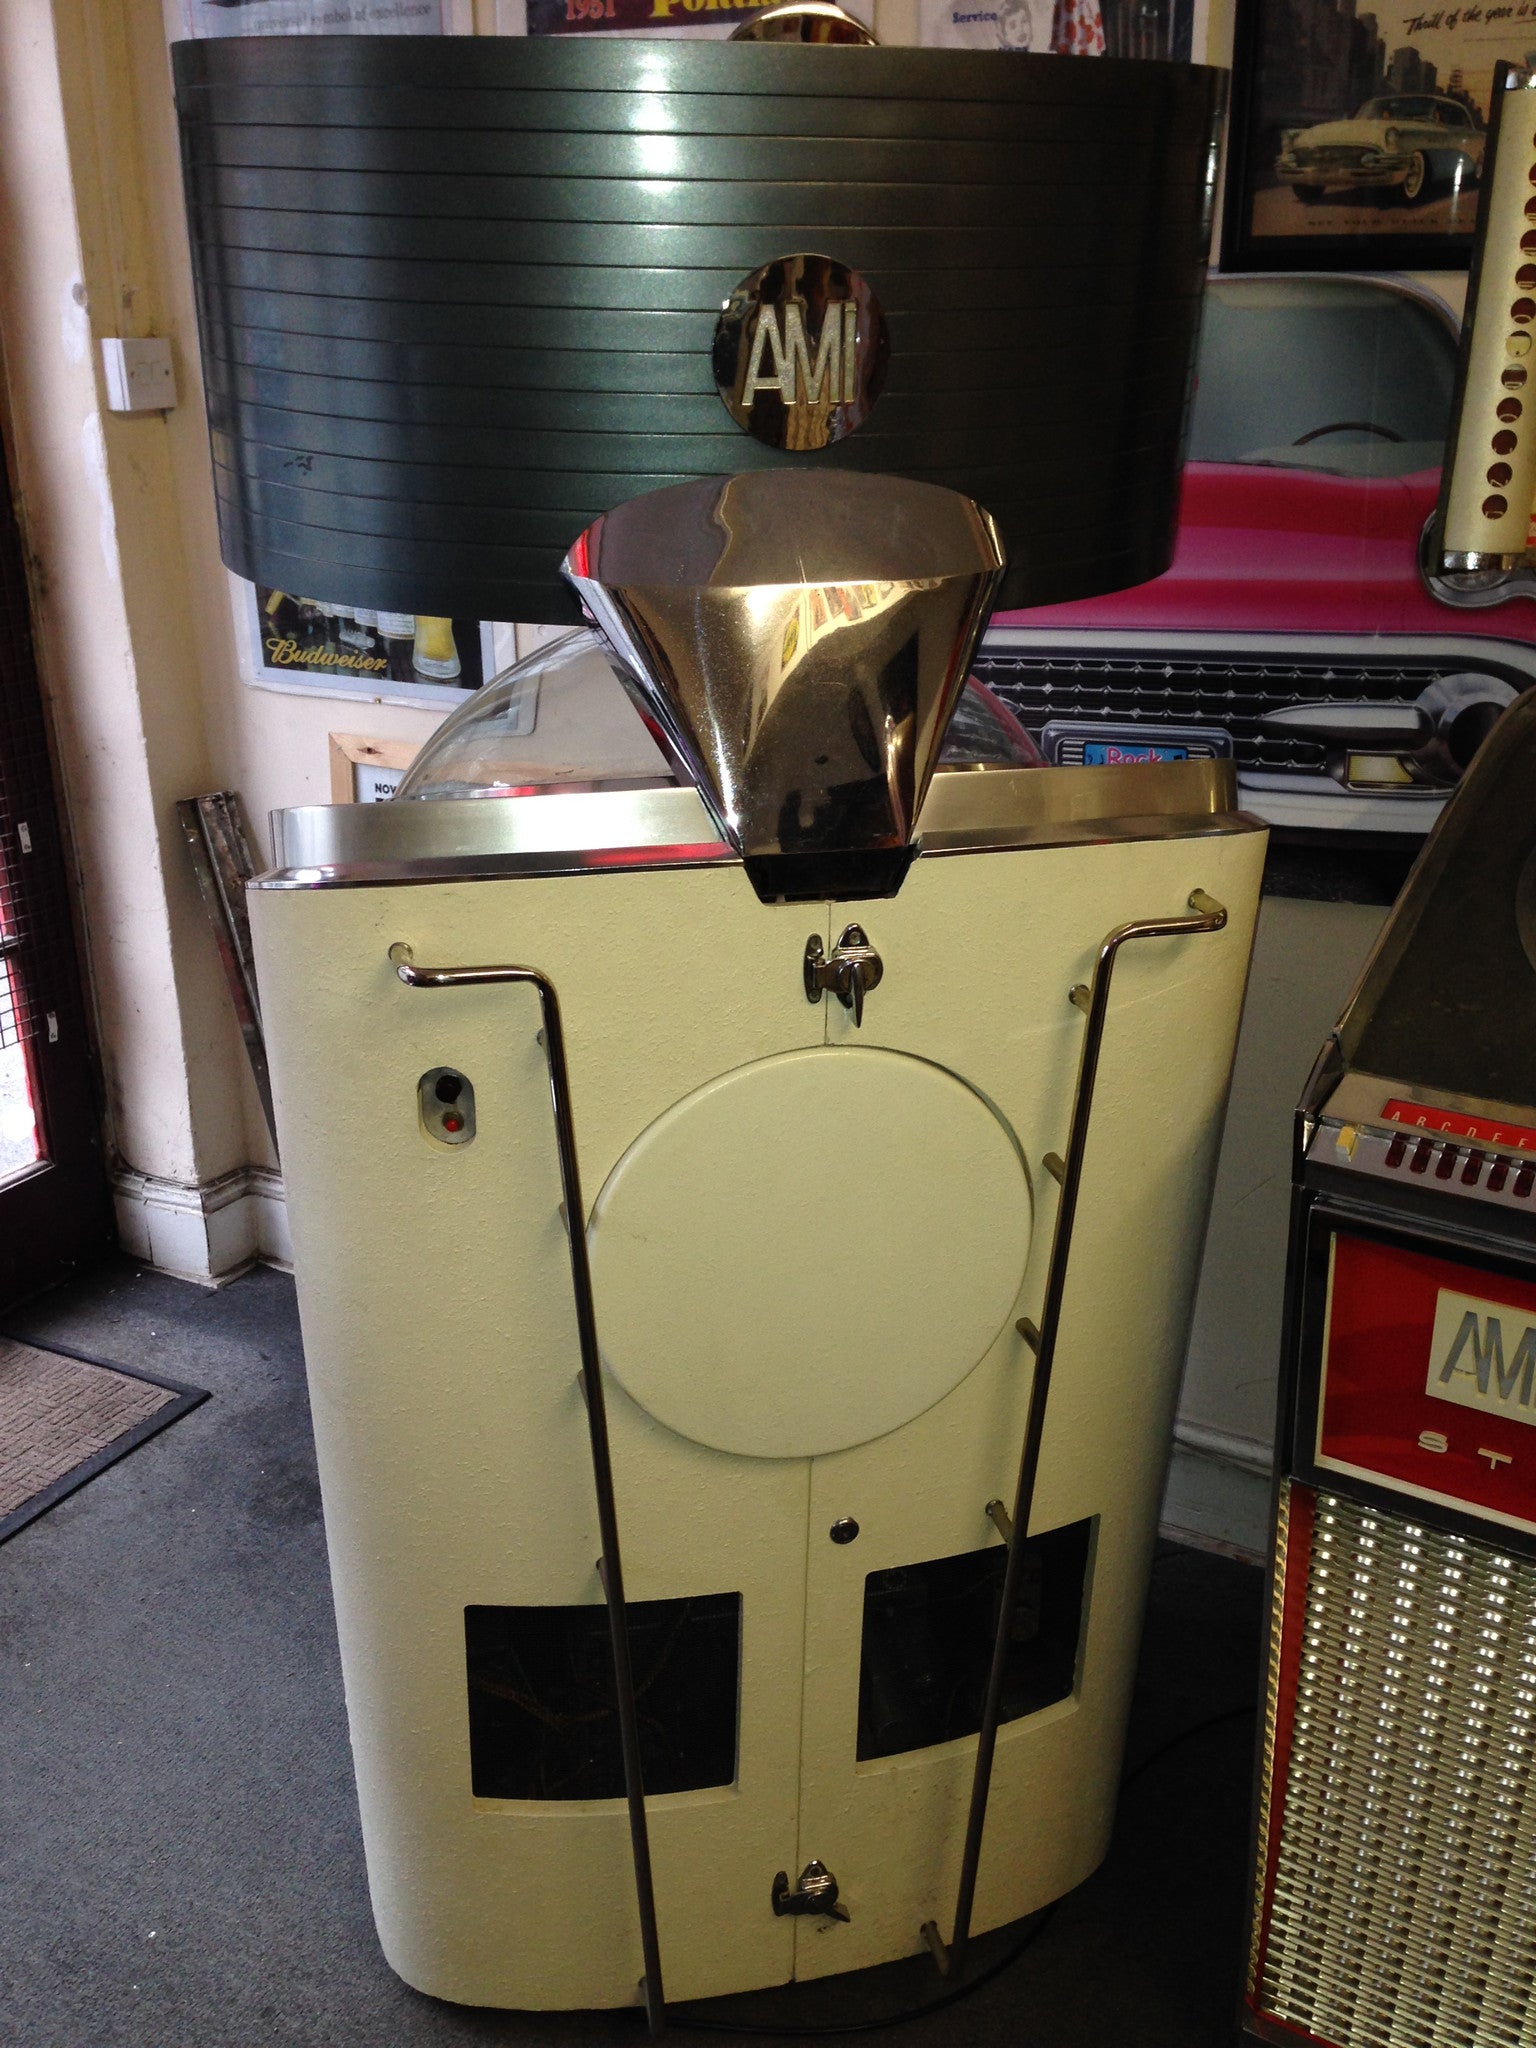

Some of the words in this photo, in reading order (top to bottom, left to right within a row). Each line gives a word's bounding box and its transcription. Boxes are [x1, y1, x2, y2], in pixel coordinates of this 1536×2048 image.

[566, 0, 616, 21] 1951
[953, 12, 998, 24] Service
[1403, 11, 1445, 35] Thrill
[1445, 7, 1462, 30] of
[1462, 4, 1482, 22] the
[741, 301, 857, 406] AMI
[265, 637, 388, 672] Budweiser
[1106, 746, 1162, 765] Rock
[1392, 1112, 1401, 1121] A
[1439, 1311, 1536, 1407] AM
